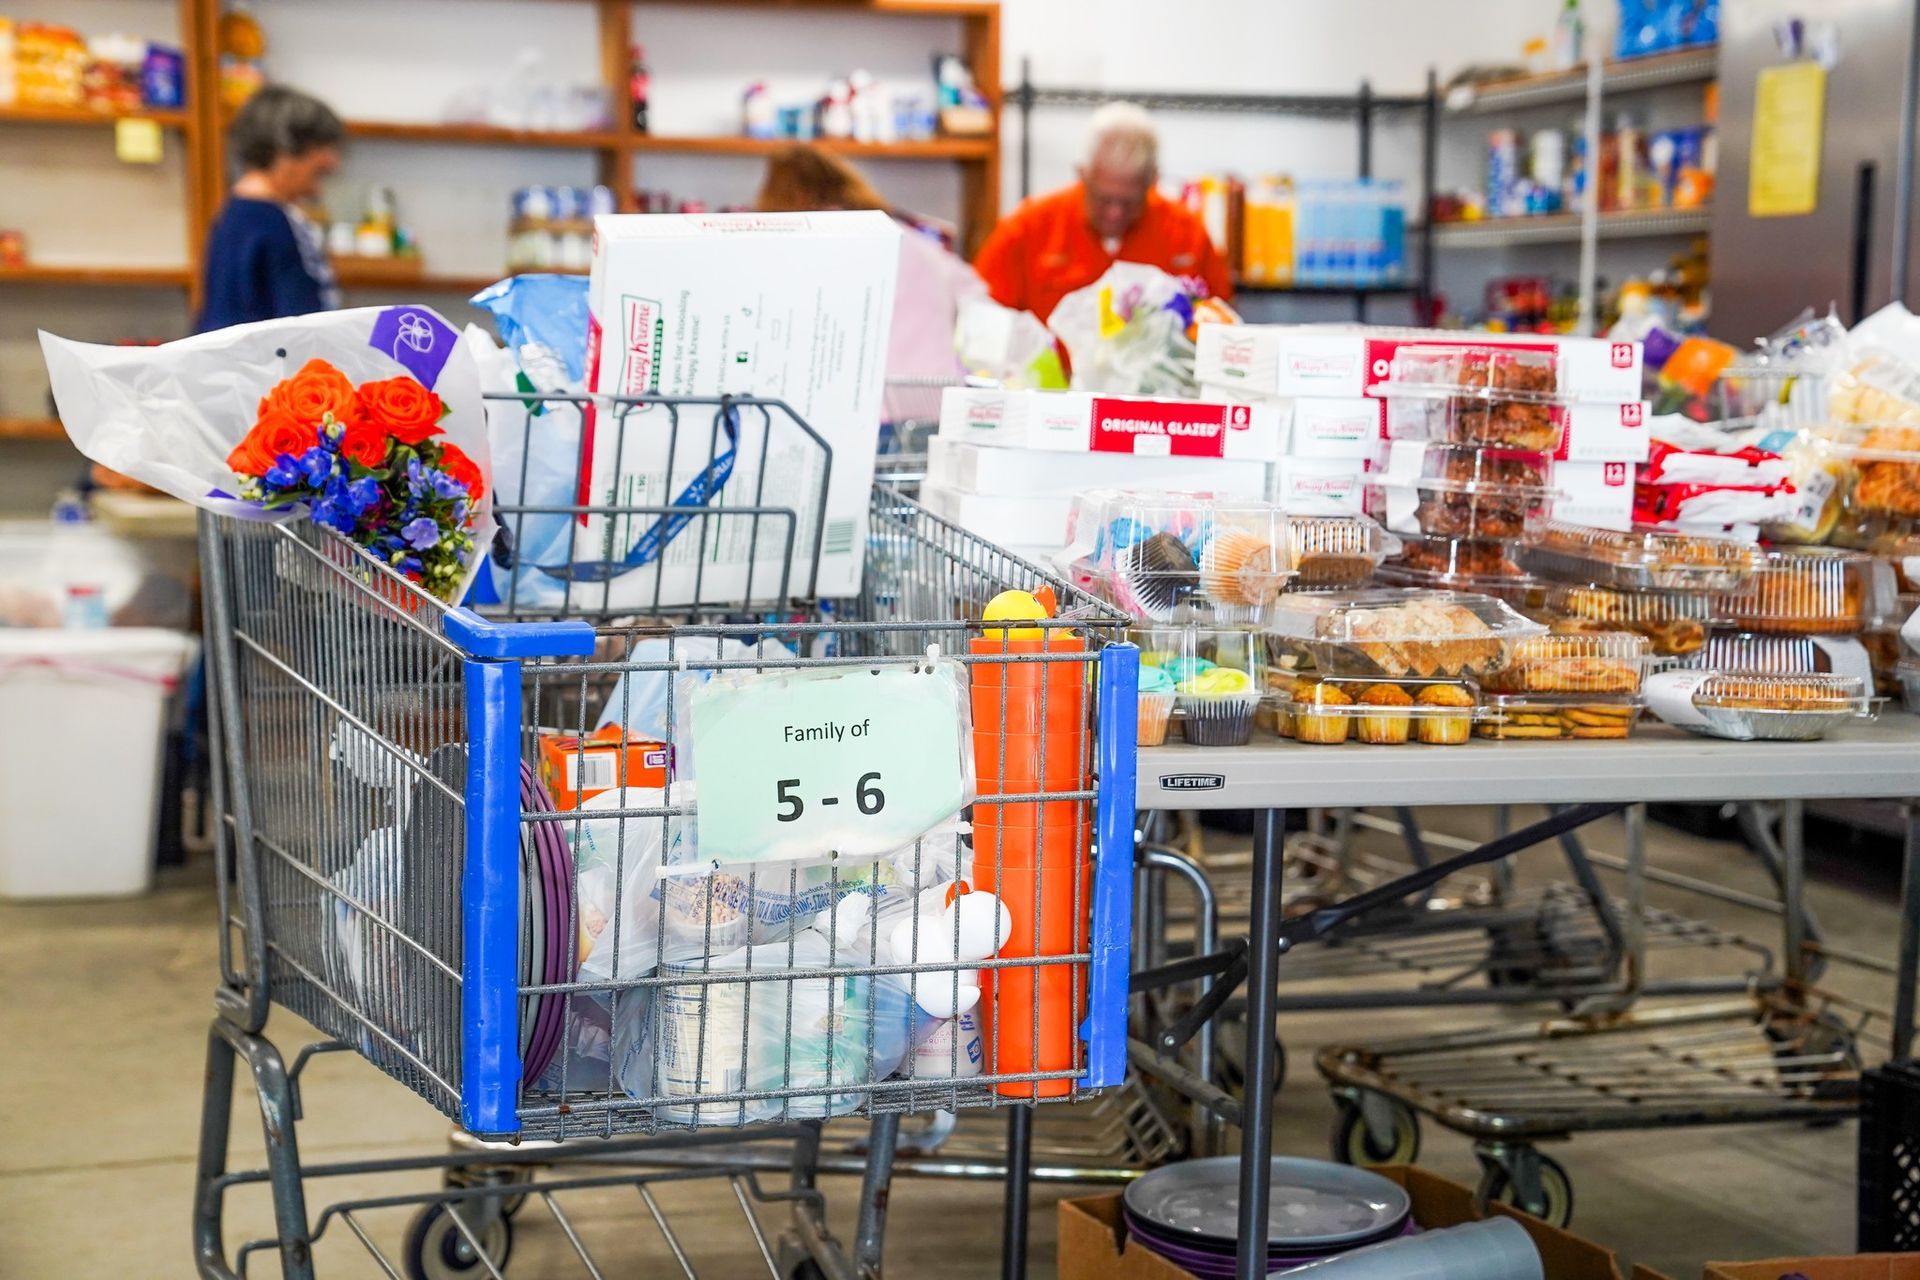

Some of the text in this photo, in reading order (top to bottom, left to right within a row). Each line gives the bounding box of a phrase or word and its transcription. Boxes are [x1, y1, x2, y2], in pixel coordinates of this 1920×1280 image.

[630, 303, 650, 354] Kreme
[1612, 345, 1632, 363] 12
[1234, 407, 1248, 424] 6
[1622, 405, 1641, 423] 12
[1101, 418, 1220, 437] ORIGINAL GLAZED
[1606, 464, 1624, 482] 12
[784, 719, 870, 743] Family of
[1167, 778, 1217, 787] LIFETIME
[777, 772, 885, 822] 5 - 6
